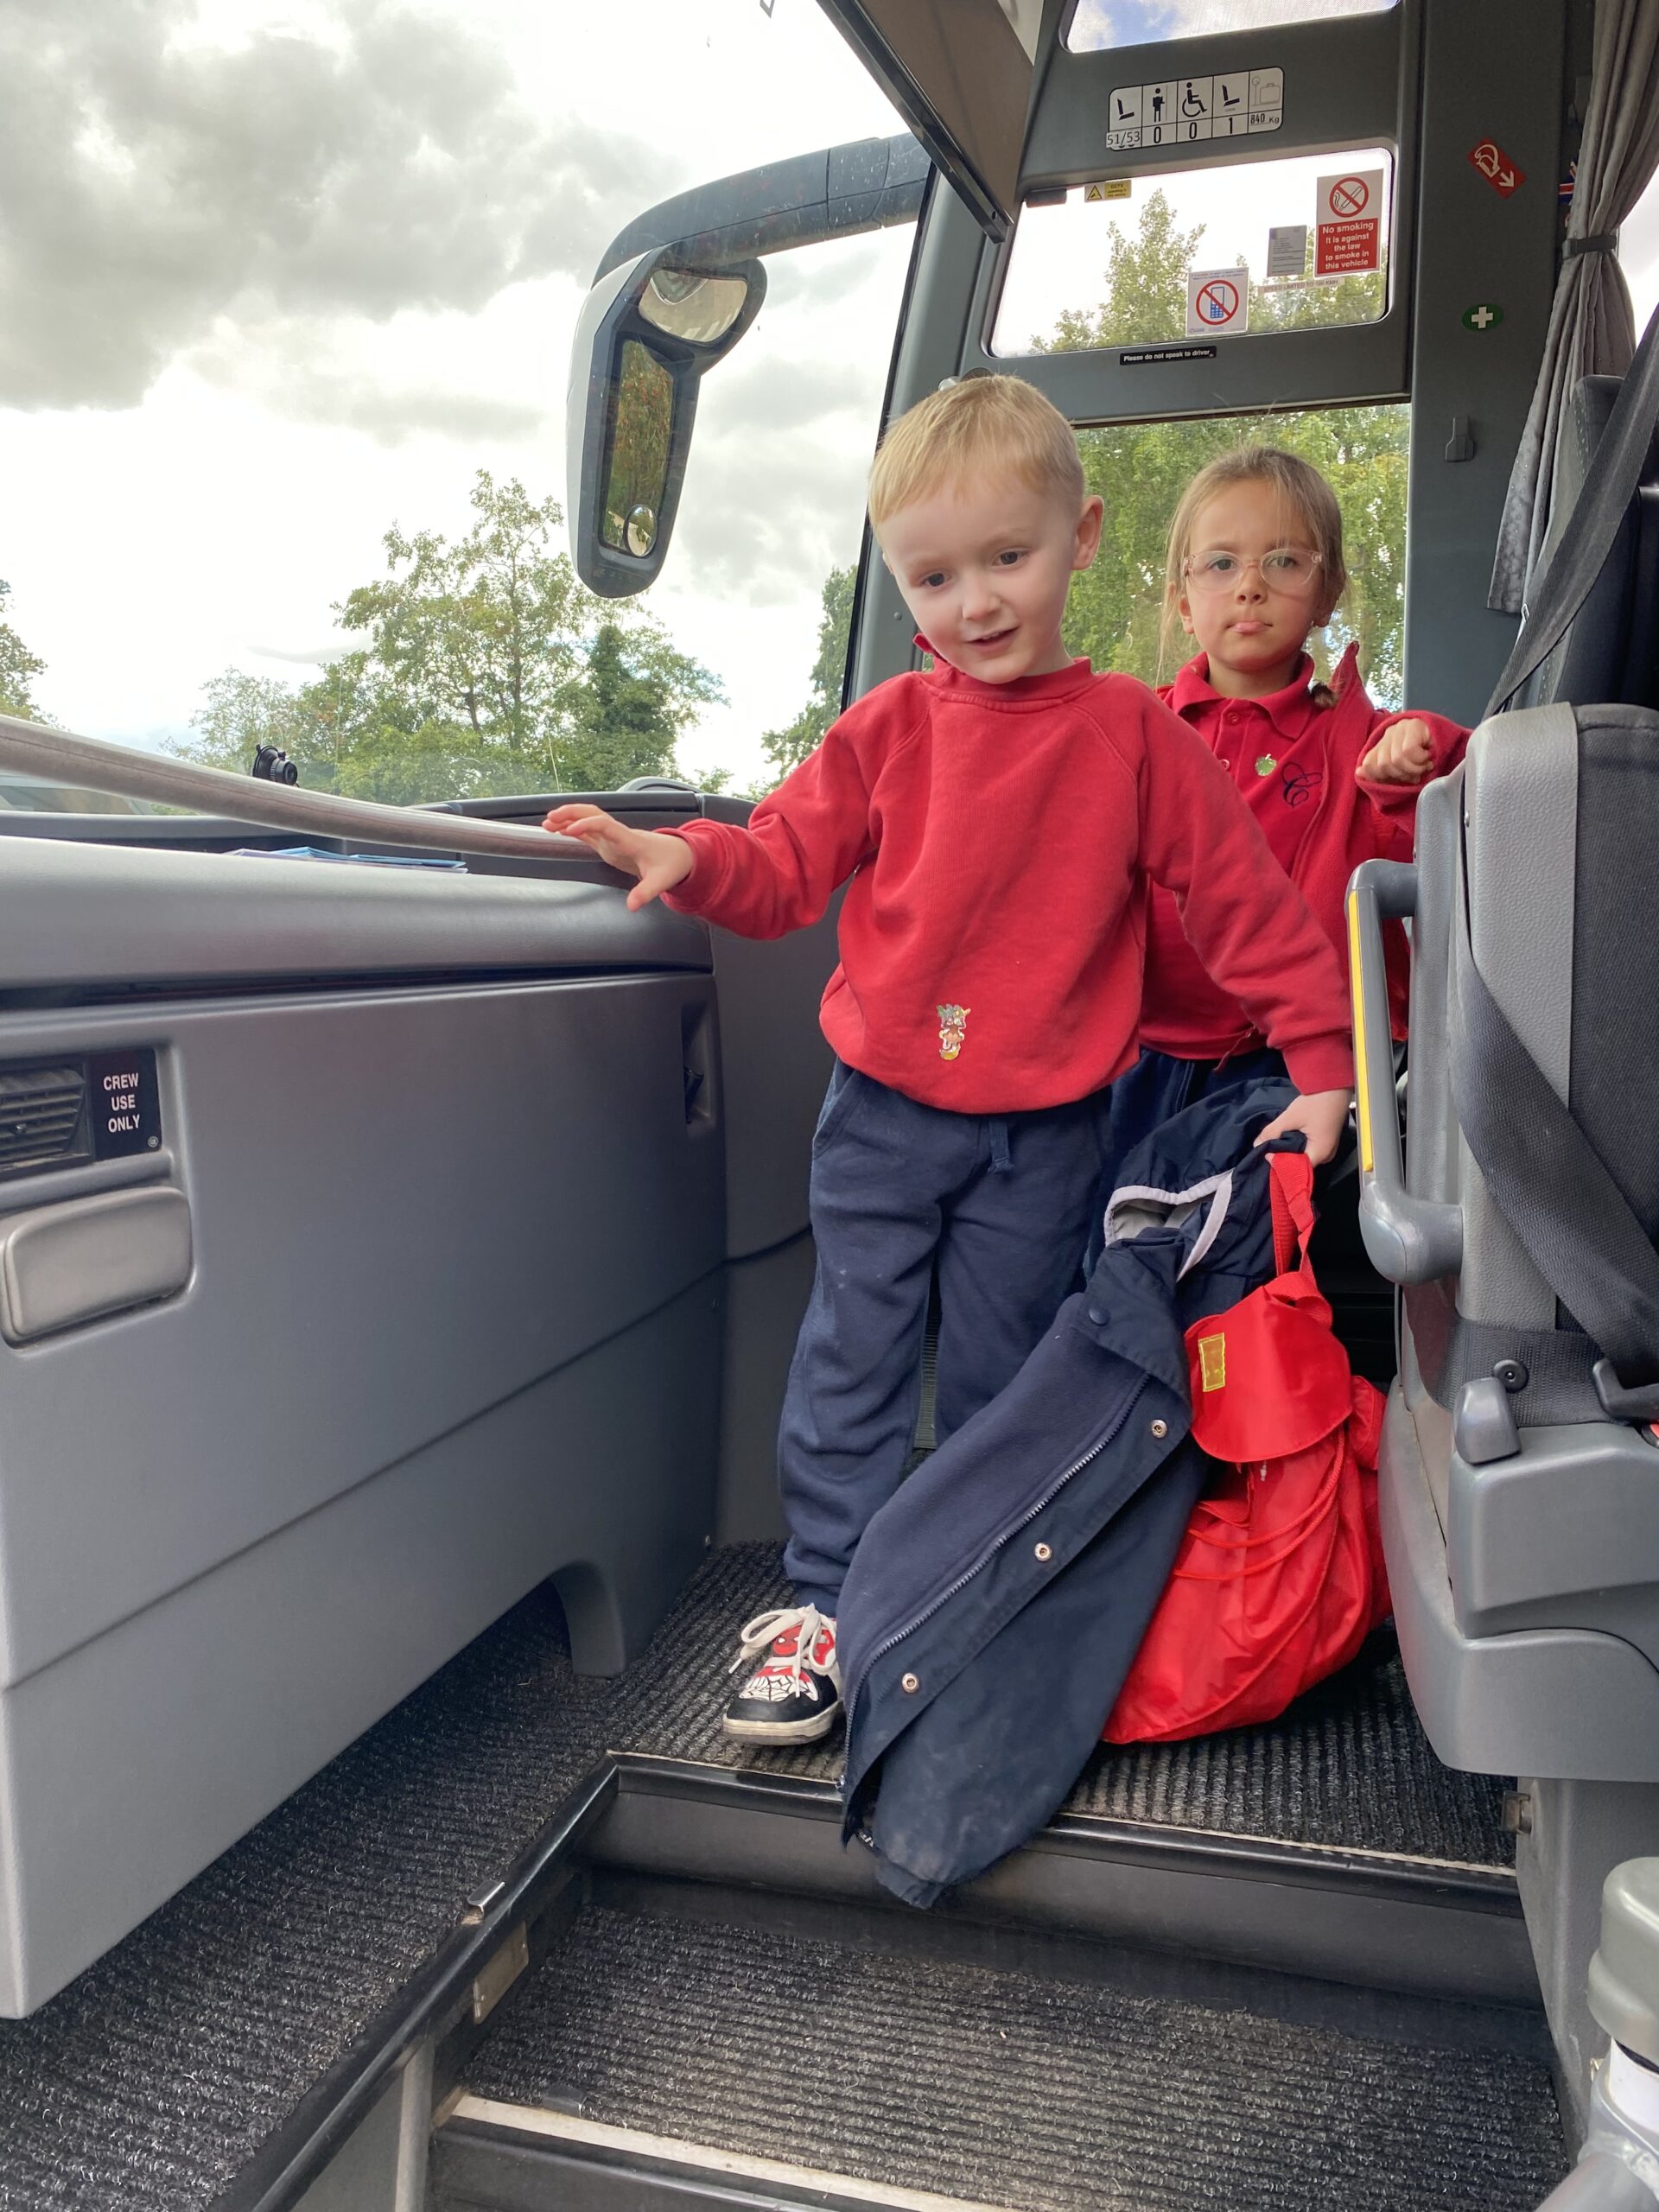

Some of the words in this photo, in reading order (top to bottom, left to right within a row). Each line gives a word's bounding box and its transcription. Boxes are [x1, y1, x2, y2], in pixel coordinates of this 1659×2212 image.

[1228, 117, 1233, 134] 1
[1250, 113, 1265, 124] 840
[1268, 116, 1280, 124] Kg
[1107, 130, 1141, 146] 51/53
[1154, 126, 1161, 143] 0
[1189, 122, 1197, 140] 0
[1322, 226, 1334, 234] No
[1337, 222, 1374, 233] smoking
[1341, 232, 1370, 244] against
[1335, 251, 1360, 260] smoke
[1341, 258, 1369, 268] vehicle
[104, 1072, 139, 1090] CREW
[111, 1094, 136, 1111] USE
[108, 1113, 140, 1133] ONLY
